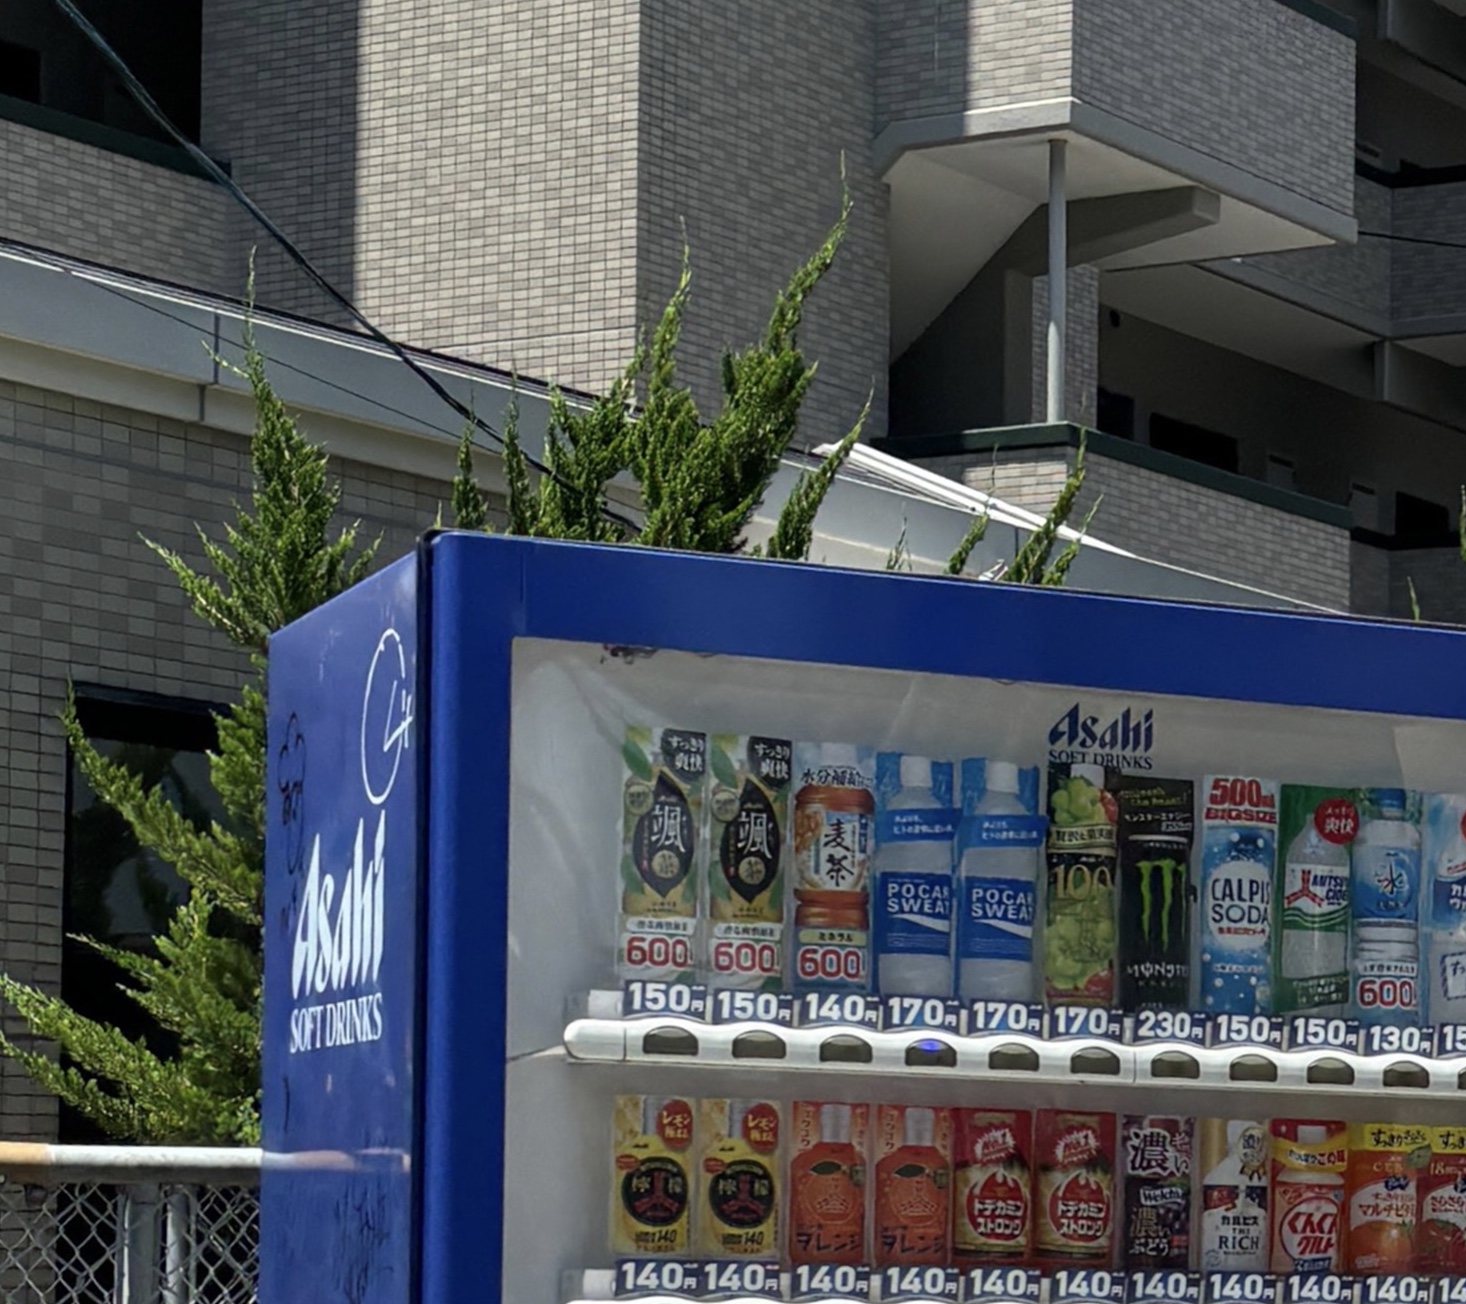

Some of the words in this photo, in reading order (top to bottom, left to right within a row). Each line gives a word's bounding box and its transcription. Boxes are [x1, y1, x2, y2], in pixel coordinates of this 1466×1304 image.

[1048, 702, 1153, 752] Asahi
[1049, 750, 1089, 764] SOFT
[1093, 752, 1153, 769] DRINKS
[823, 818, 854, 887] 麦茶
[292, 809, 385, 1000] Asahi
[625, 936, 690, 968] 600
[713, 941, 777, 973] 600
[799, 948, 861, 979] 600
[628, 982, 704, 1013] 150円
[717, 989, 791, 1021] 150円
[1359, 978, 1413, 1008] 600
[805, 993, 878, 1023] 140円
[888, 997, 957, 1027] 170円
[973, 1002, 1040, 1031] 170円
[1055, 1006, 1120, 1035] 170円
[289, 1004, 324, 1054] SOFT
[325, 992, 382, 1047] DRINKS
[1138, 1010, 1203, 1039] 230円
[1217, 1015, 1281, 1043] 150円
[1294, 1018, 1357, 1046] 150円
[1370, 1025, 1431, 1053] 130円
[662, 1110, 691, 1127] レモン
[747, 1114, 776, 1129] レモン
[1218, 1236, 1259, 1250] RICH
[622, 1262, 697, 1290] 140円
[704, 1263, 778, 1291] 140円
[796, 1265, 868, 1292] 140円
[887, 1267, 957, 1294] 140円
[970, 1268, 1039, 1296] 140円
[1055, 1270, 1123, 1297] 140円
[1132, 1272, 1198, 1298] 140円
[1210, 1273, 1275, 1300] 140円
[1288, 1274, 1352, 1301] 140円
[1366, 1276, 1428, 1302] 140円
